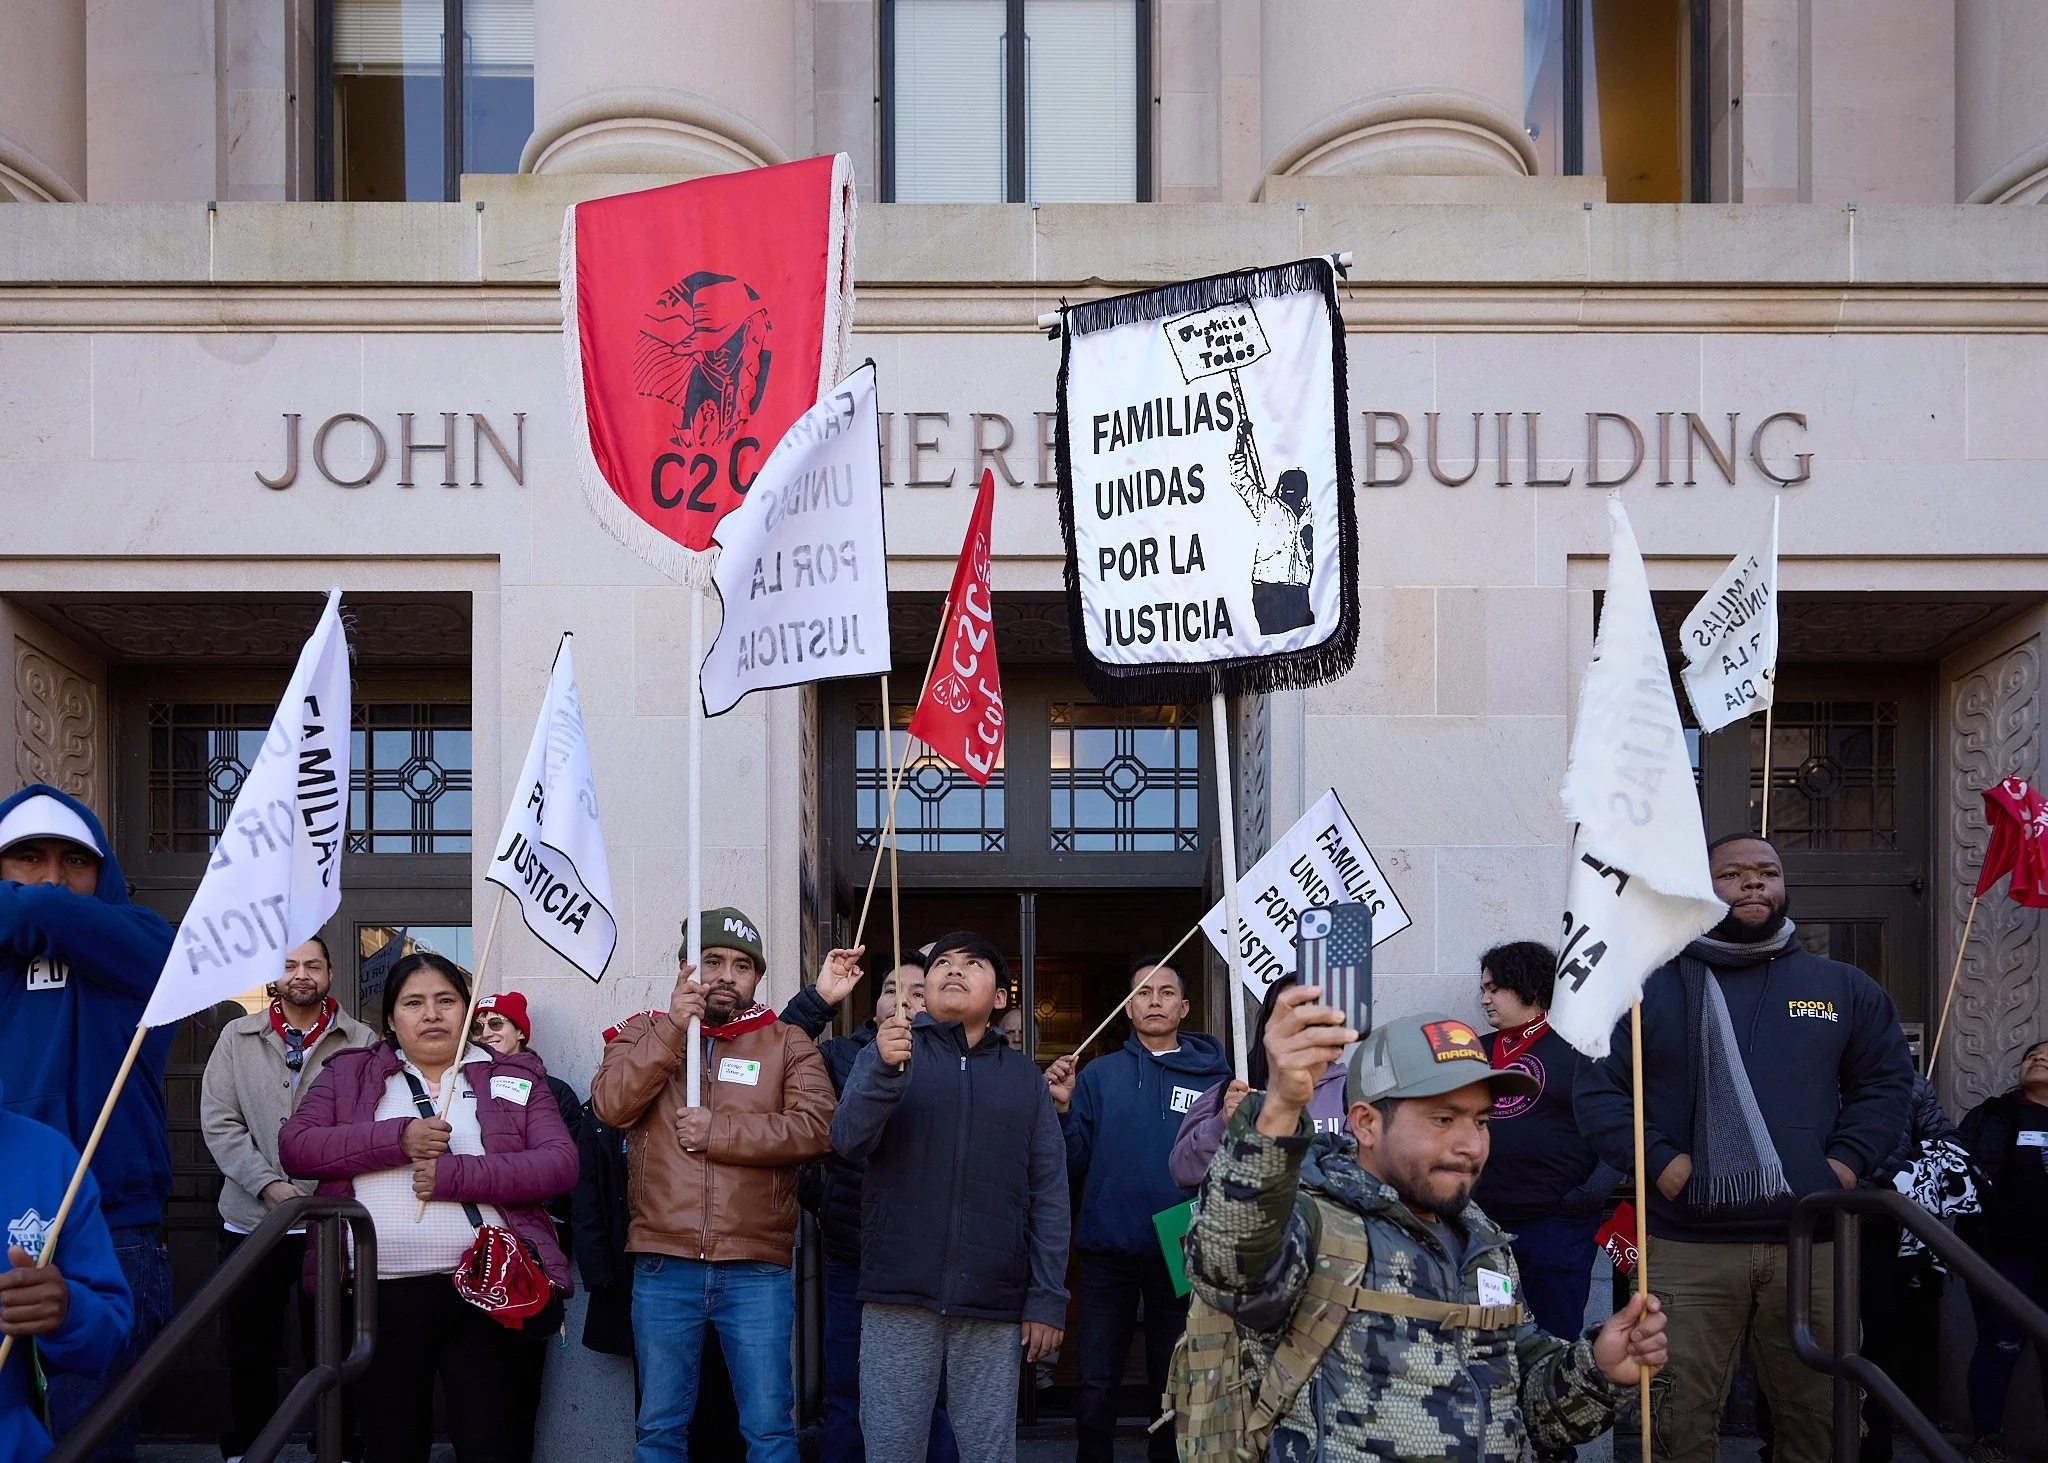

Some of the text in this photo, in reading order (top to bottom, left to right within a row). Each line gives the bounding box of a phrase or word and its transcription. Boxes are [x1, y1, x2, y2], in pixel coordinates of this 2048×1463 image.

[1178, 315, 1246, 342] Justicia
[1093, 391, 1234, 455] FAMILIAS
[255, 412, 526, 490] JOHN
[1362, 411, 1814, 488] BUILDING
[651, 437, 760, 513] C2C
[1096, 463, 1205, 520] UNIDAS
[1100, 534, 1205, 582] POR LA
[1104, 597, 1234, 647] JUSTICIA
[497, 832, 593, 936] JUSTICIA
[1289, 854, 1339, 907] UNID
[1316, 824, 1385, 918] FAMILIAS
[1788, 1000, 1825, 1010] FOOD
[1789, 1008, 1839, 1022] LIFELINE
[1437, 1049, 1487, 1062] MAGPUL
